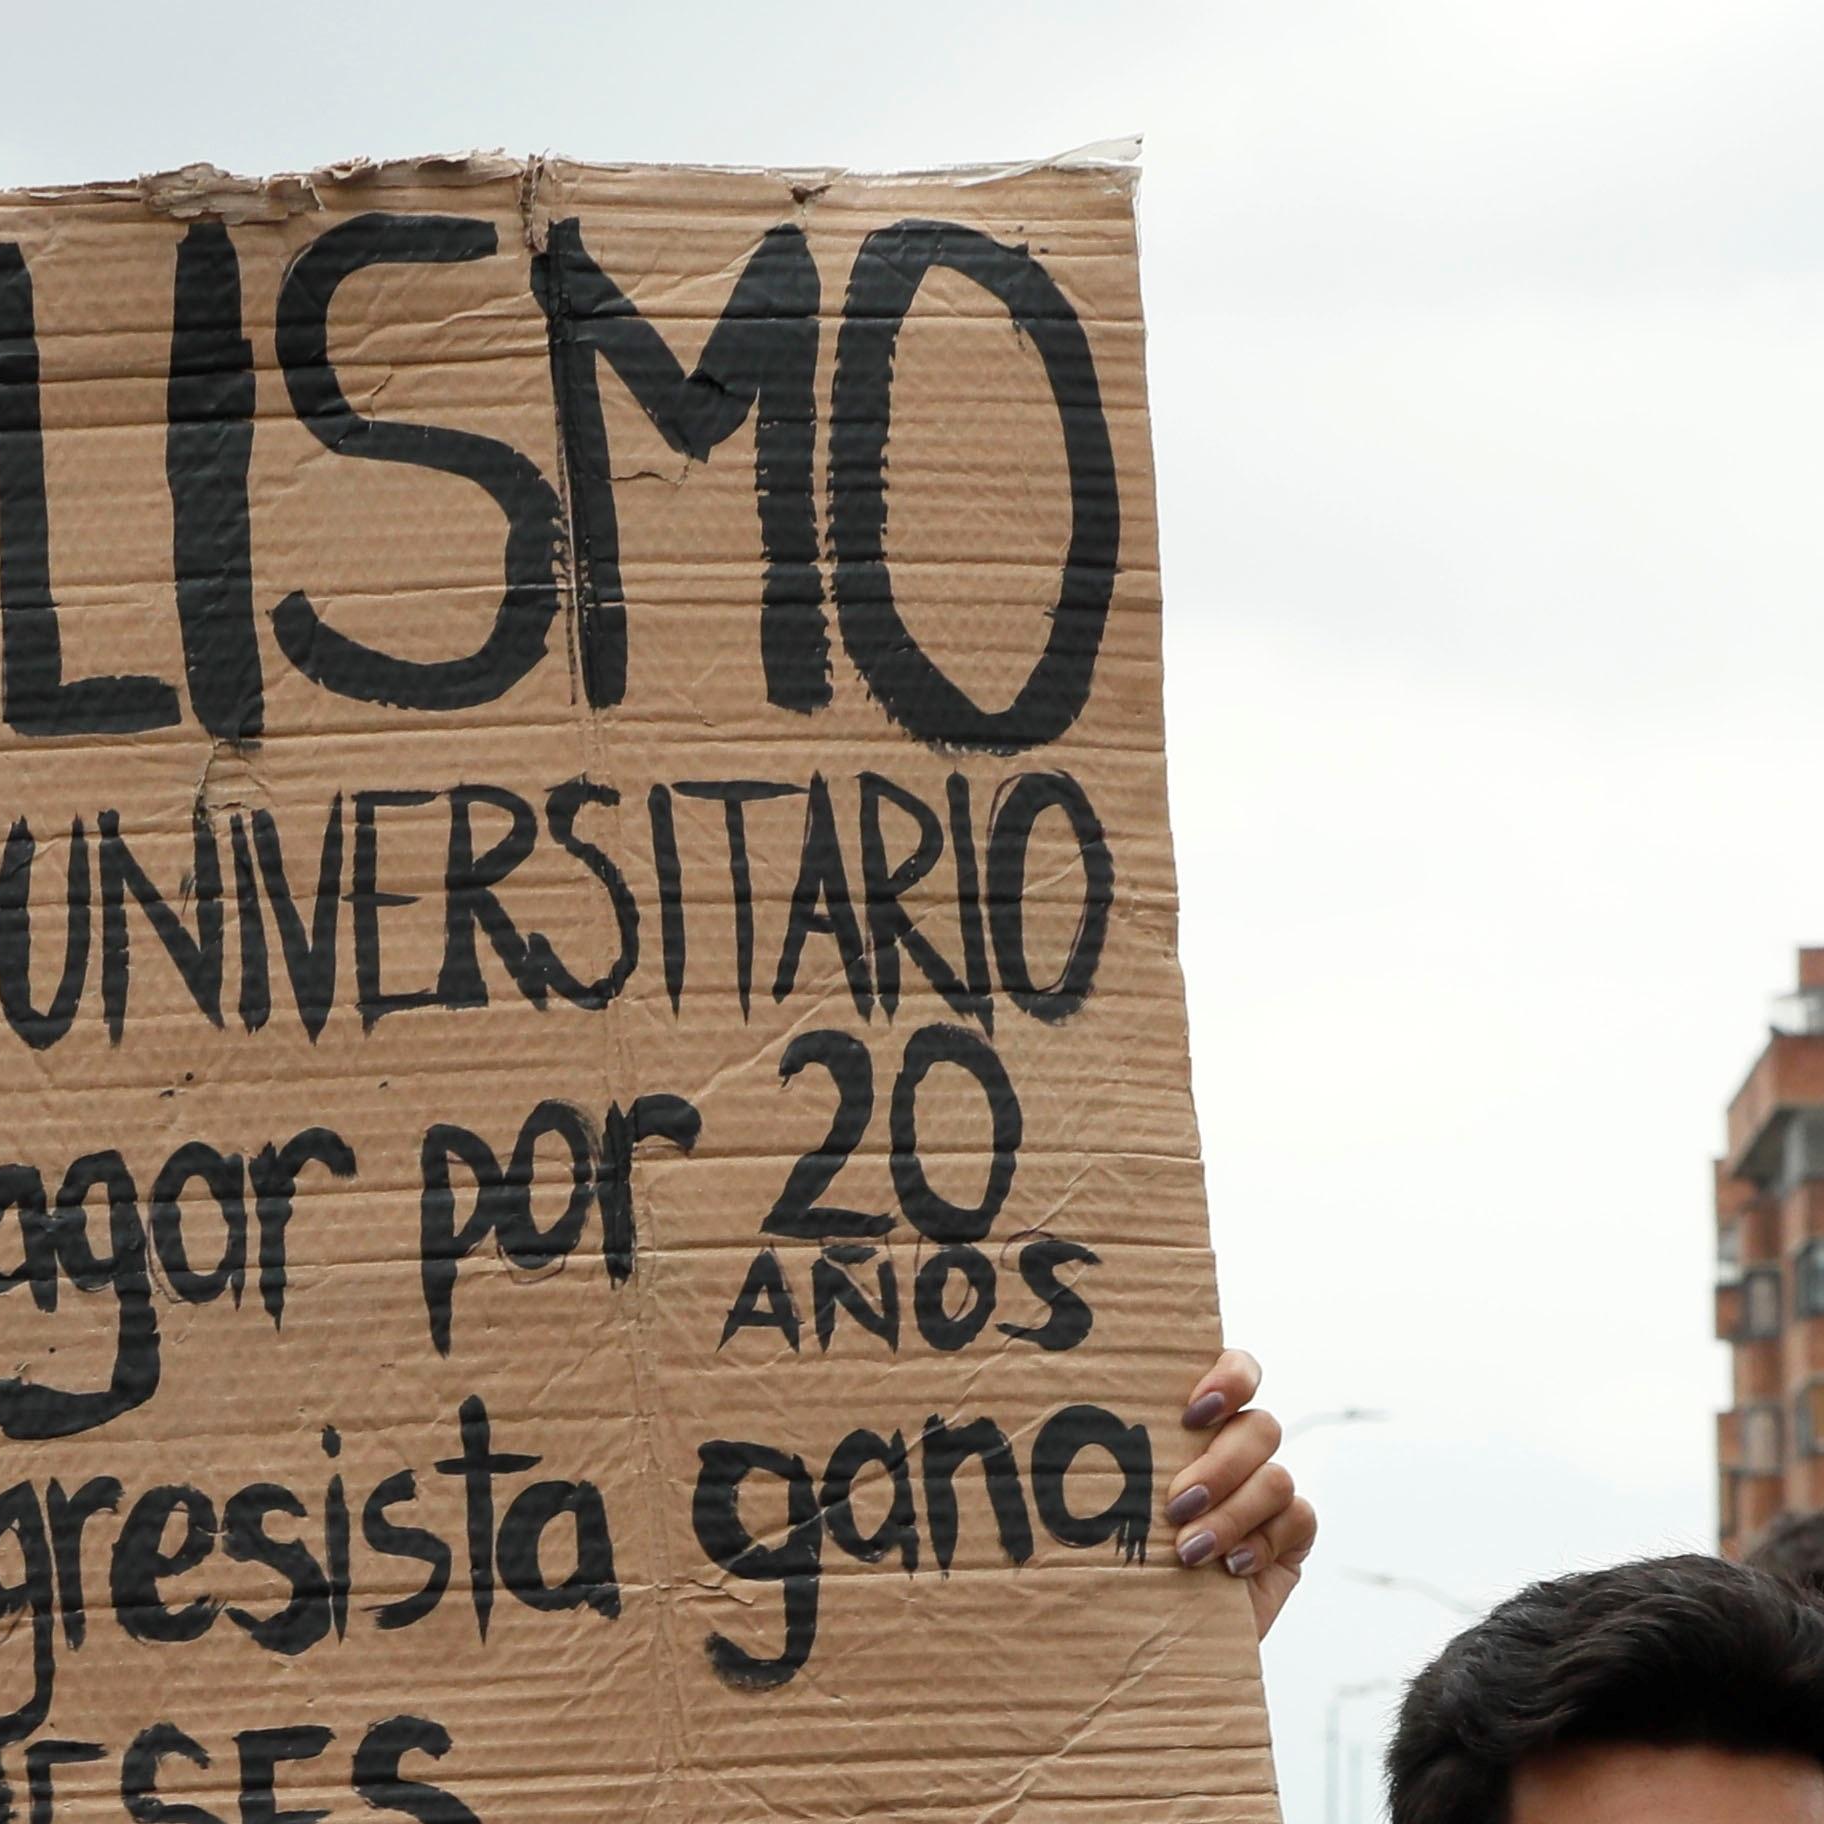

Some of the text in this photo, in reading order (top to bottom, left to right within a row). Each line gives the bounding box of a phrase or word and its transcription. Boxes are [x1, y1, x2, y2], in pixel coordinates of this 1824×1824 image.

[420, 1094, 703, 1357] por
[761, 1023, 1023, 1244] 20
[717, 1237, 1102, 1353] AÑOS
[693, 1403, 1155, 1692] gana
